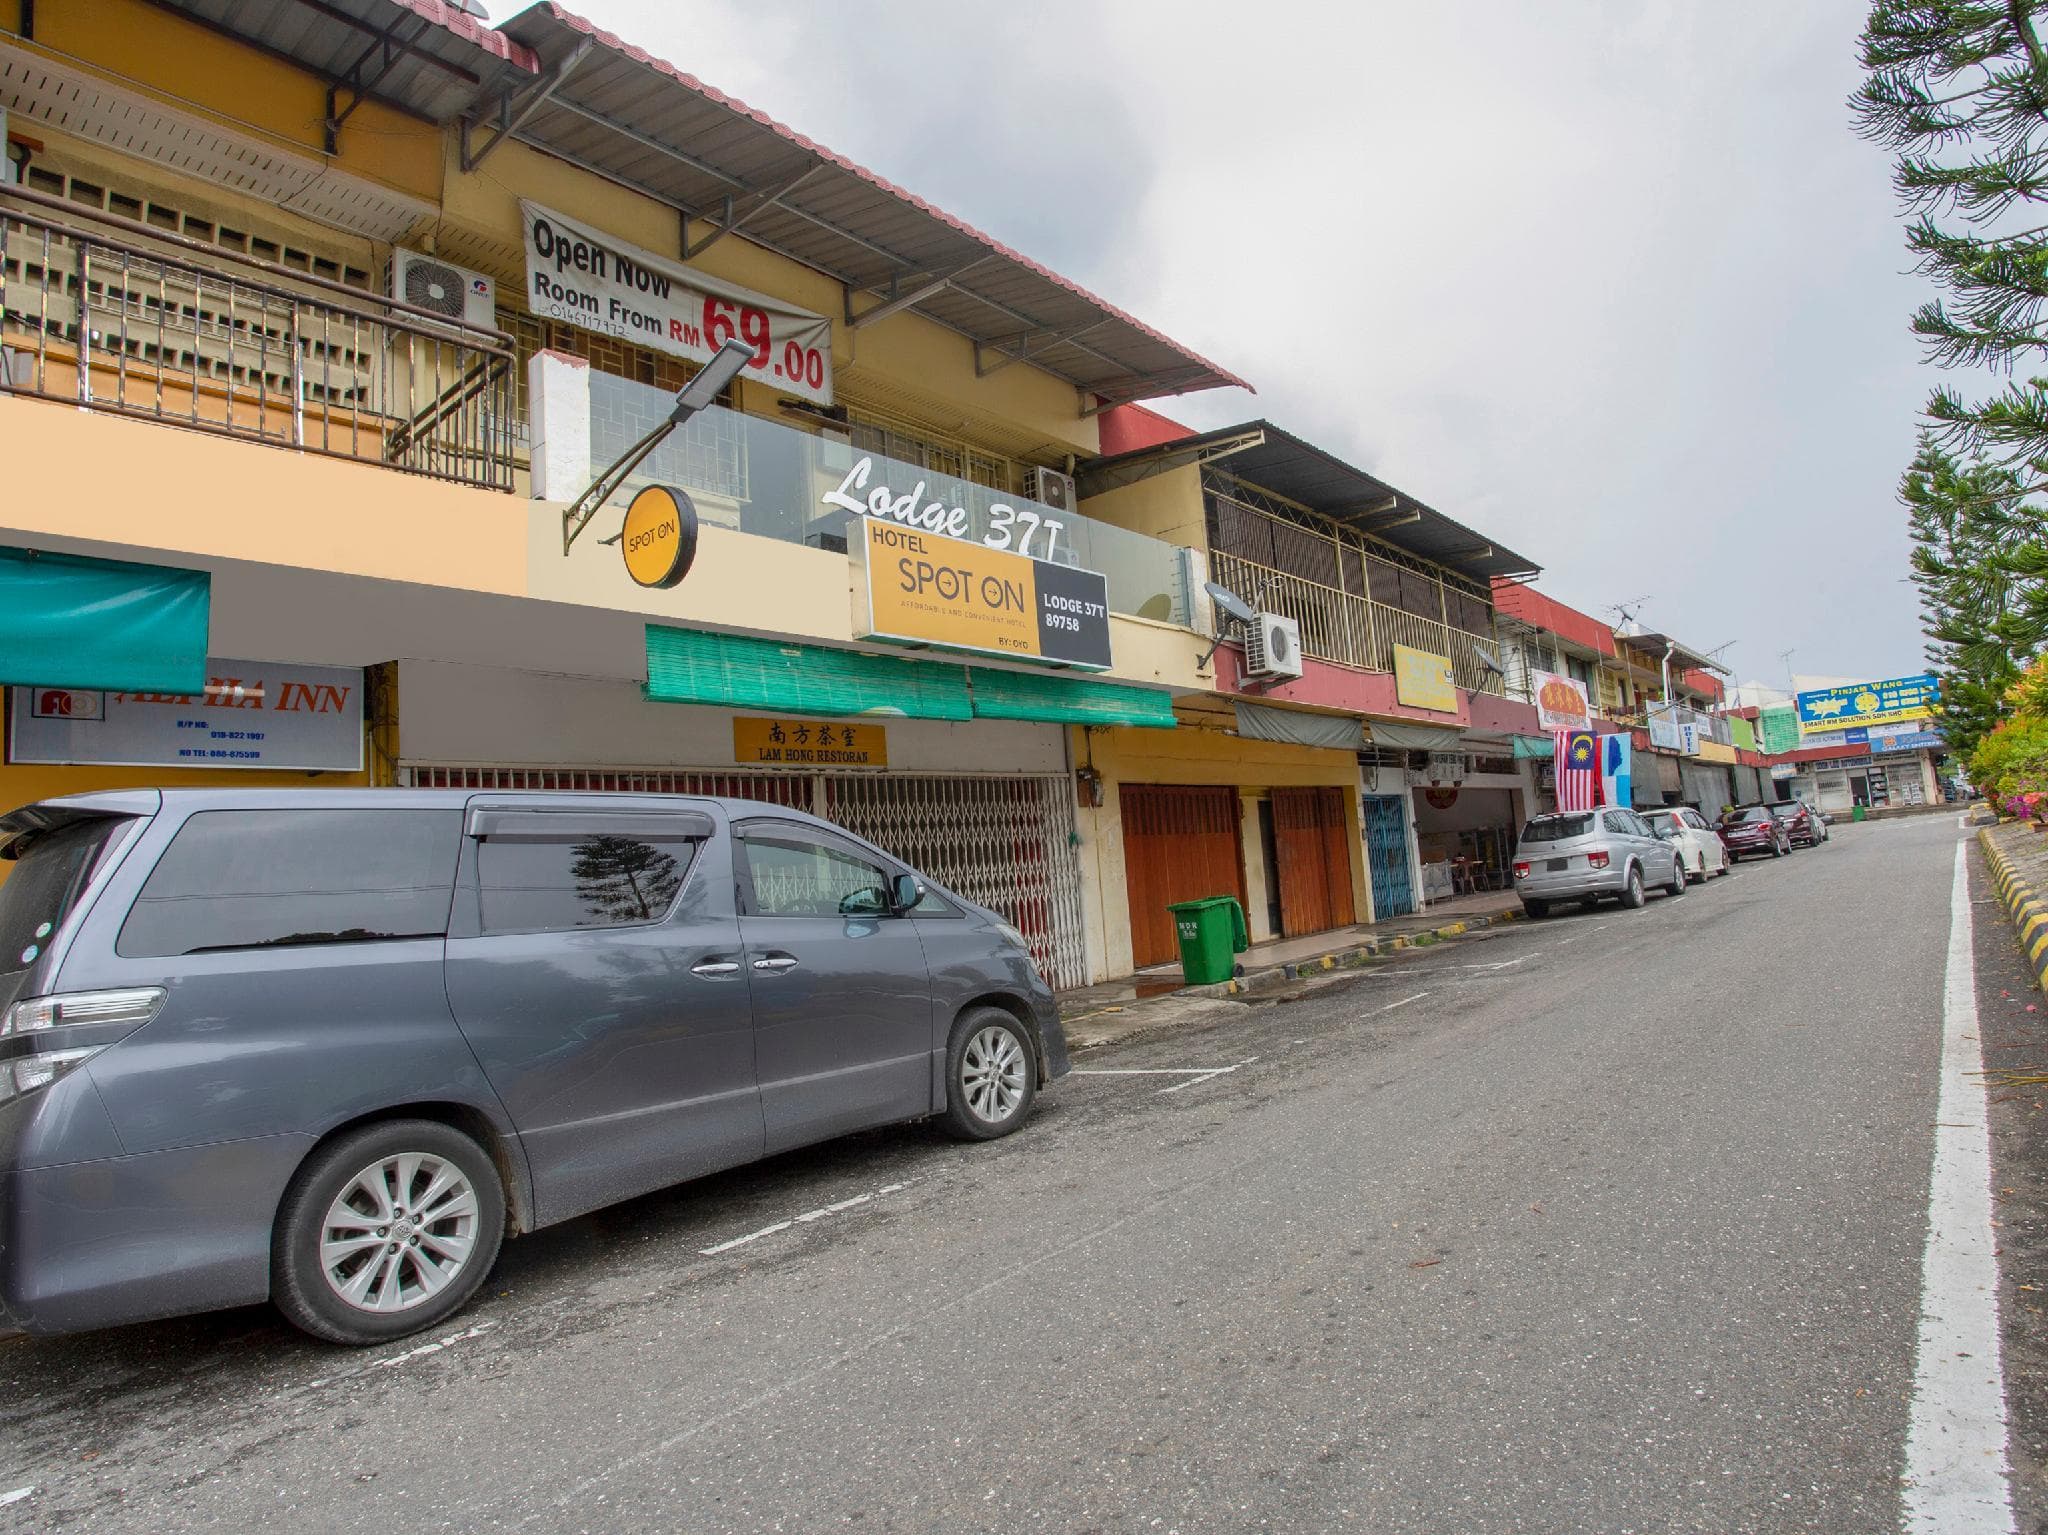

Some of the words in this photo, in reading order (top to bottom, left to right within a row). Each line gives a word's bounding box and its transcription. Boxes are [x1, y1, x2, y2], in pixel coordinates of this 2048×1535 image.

[534, 219, 606, 278] Open
[616, 254, 671, 300] Now
[534, 272, 599, 314] Room
[609, 297, 662, 336] From
[669, 318, 700, 348] RM
[703, 295, 823, 390] 69.00
[822, 457, 968, 536] Lodge
[984, 503, 1063, 562] 37T
[629, 528, 656, 553] SPOT
[658, 518, 675, 539] ON
[872, 526, 928, 555] HOTEL
[899, 557, 973, 604] SPOT
[981, 574, 1026, 614] ON
[948, 608, 962, 617] AND
[1044, 593, 1083, 614] LODGE
[1084, 601, 1105, 618] 37T
[1045, 613, 1080, 632] 89758
[273, 681, 352, 714] INN
[758, 747, 781, 761] LAM
[785, 748, 814, 762] HONG
[816, 750, 868, 763] RESTORAN
